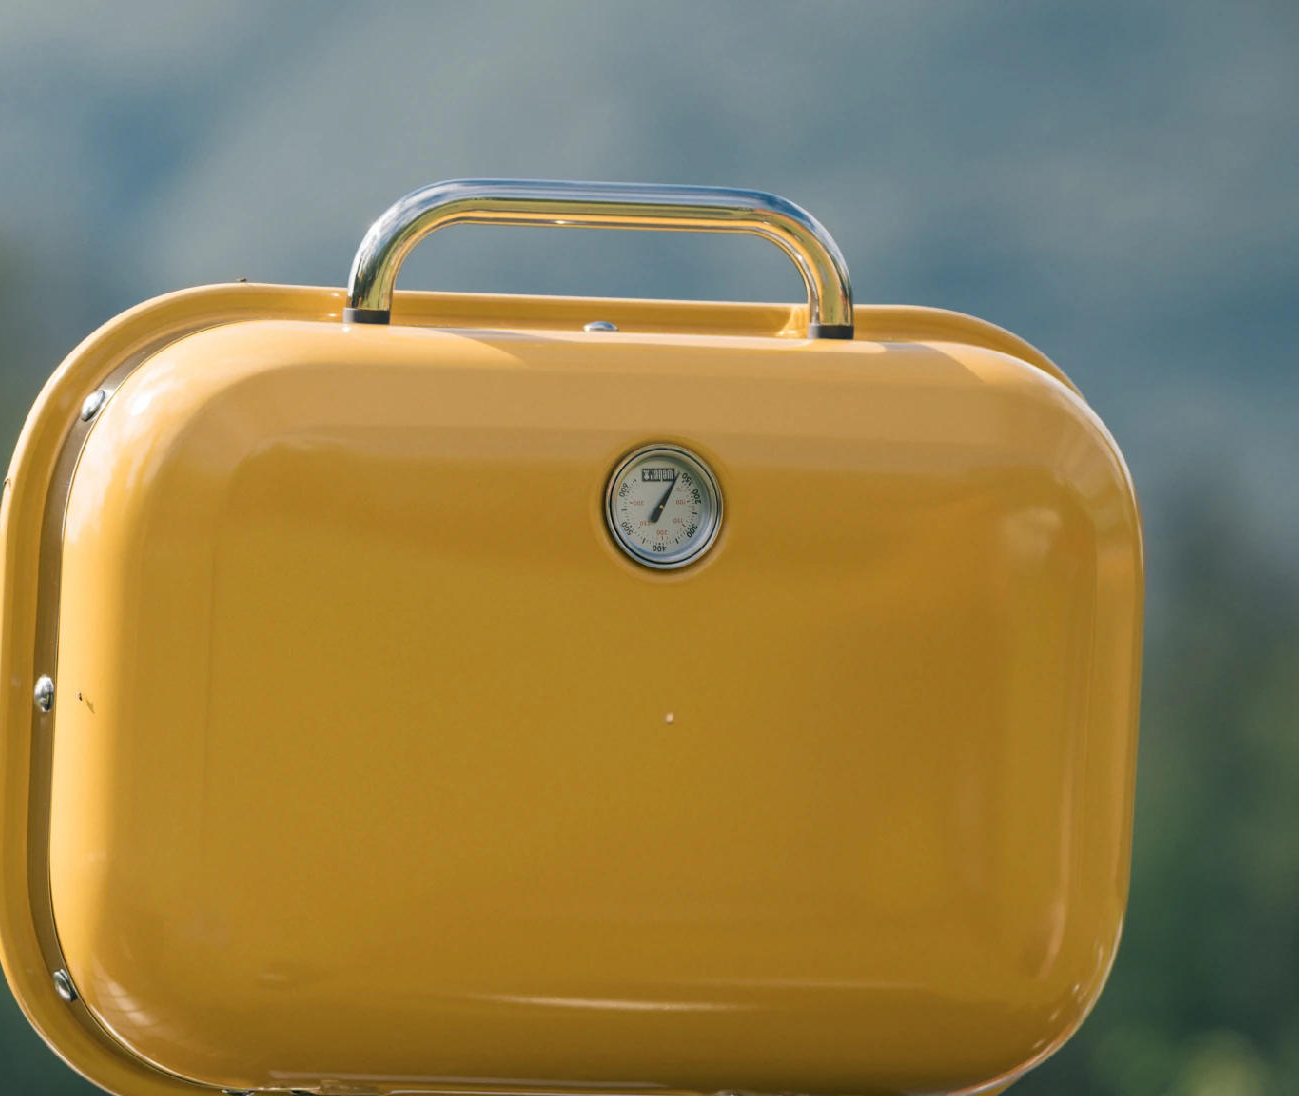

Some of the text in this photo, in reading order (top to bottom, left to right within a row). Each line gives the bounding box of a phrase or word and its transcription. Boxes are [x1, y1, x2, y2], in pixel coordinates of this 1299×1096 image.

[682, 472, 693, 486] 150
[618, 482, 629, 497] 600
[692, 489, 702, 505] 200
[621, 522, 634, 536] 500
[686, 524, 698, 538] 300
